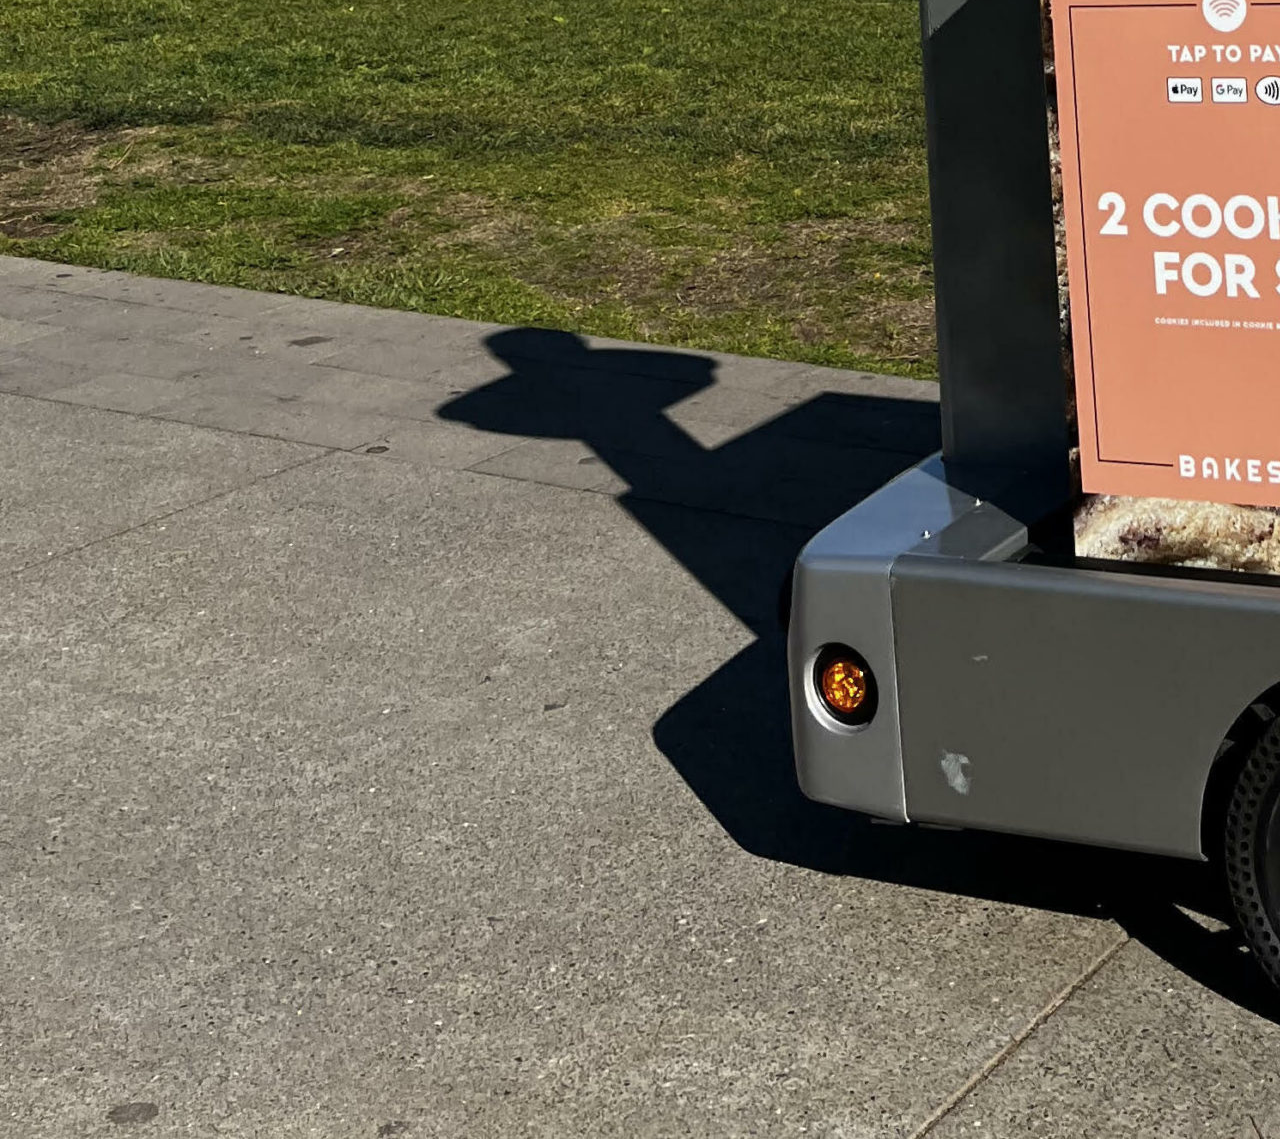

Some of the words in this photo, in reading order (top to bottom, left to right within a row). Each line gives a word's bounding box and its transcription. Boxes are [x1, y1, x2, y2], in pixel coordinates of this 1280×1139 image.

[1167, 45, 1207, 63] TAP
[1211, 44, 1242, 63] TO
[1180, 84, 1199, 97] Pay
[1098, 192, 1128, 235] 2
[1153, 251, 1260, 298] FOR
[1155, 317, 1189, 325] COOKIES
[1192, 319, 1230, 328] INCLUDED
